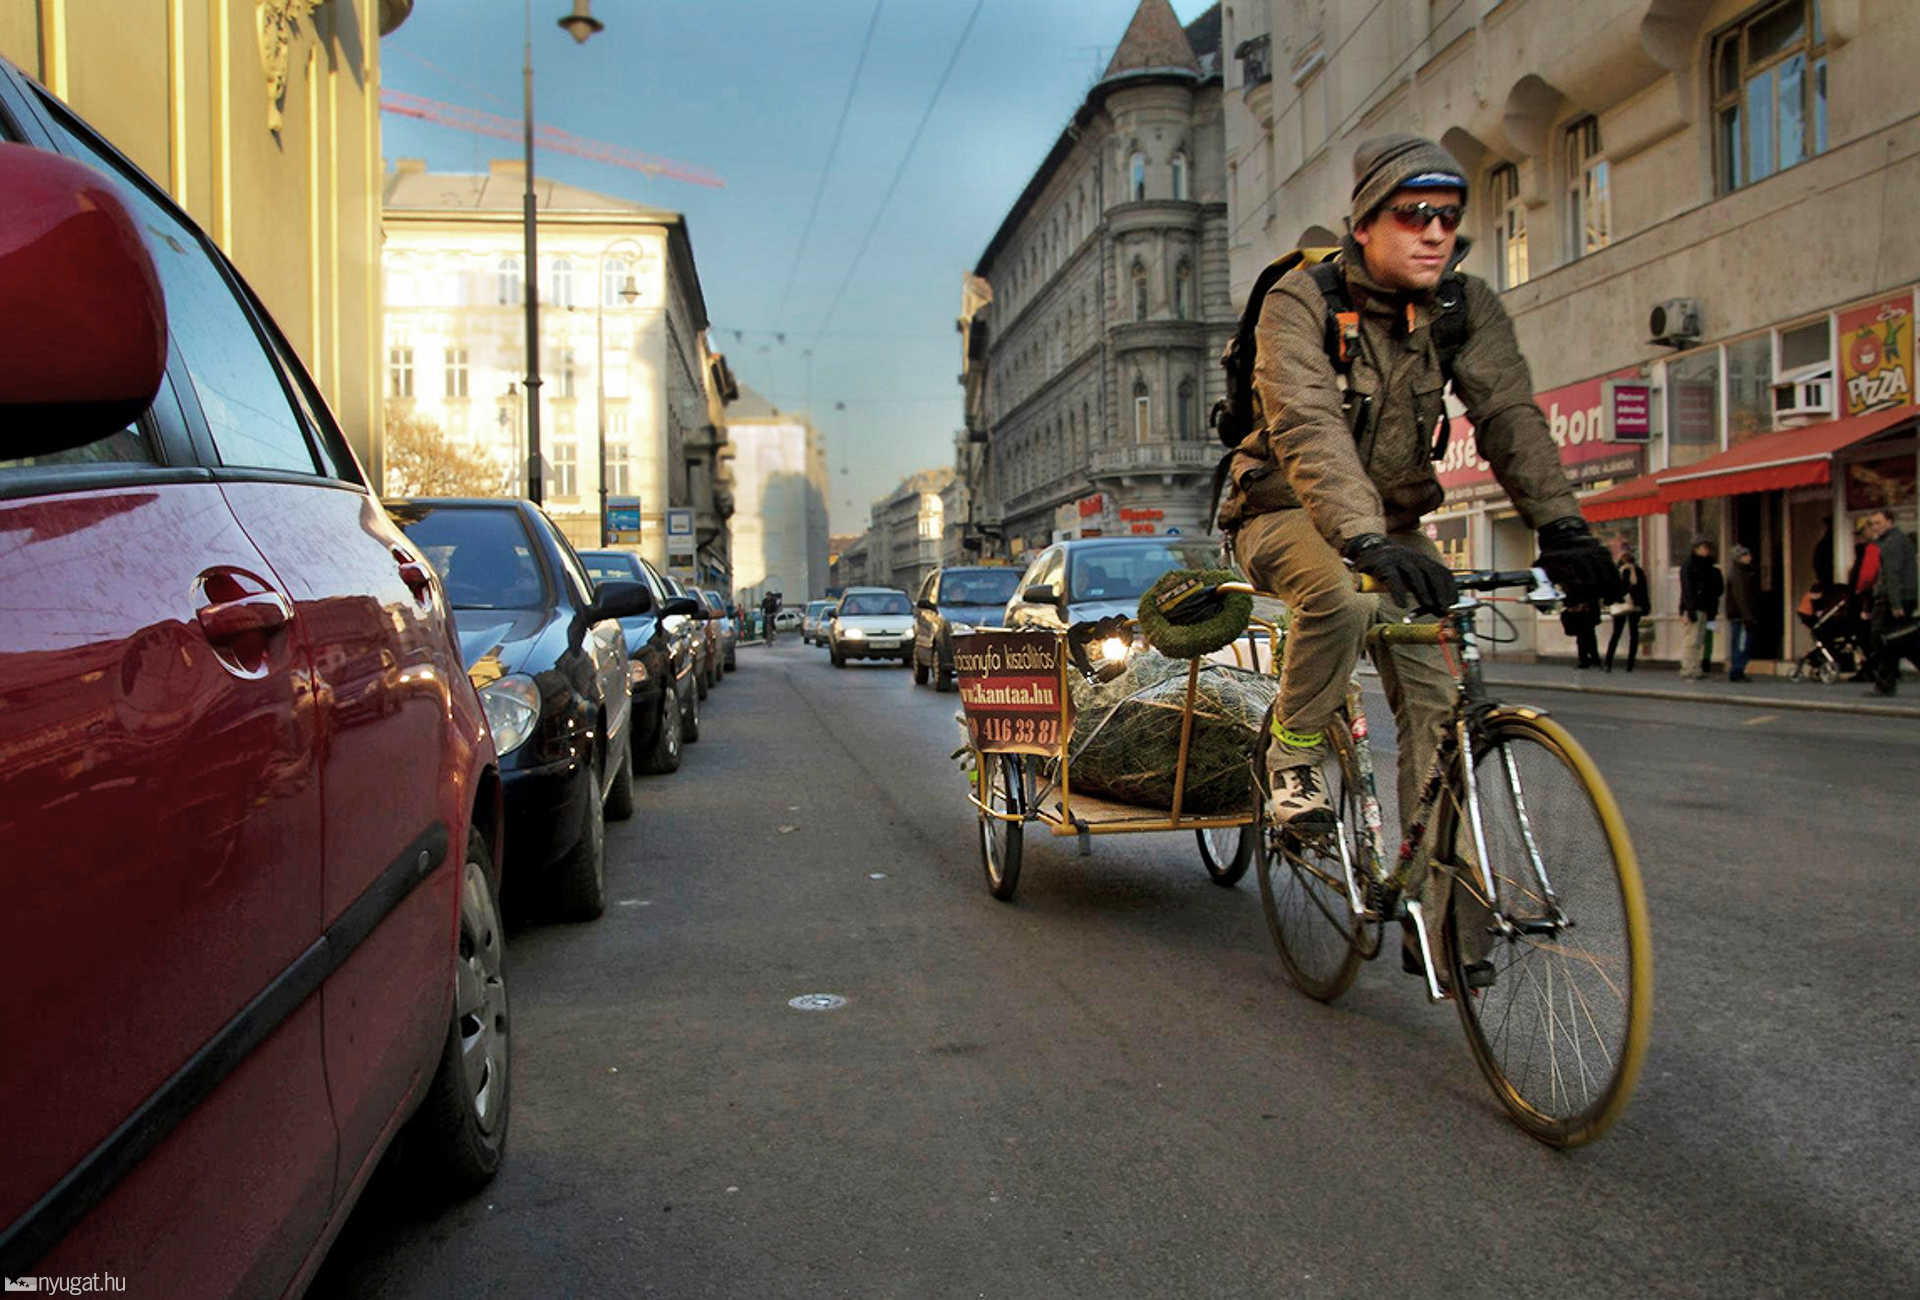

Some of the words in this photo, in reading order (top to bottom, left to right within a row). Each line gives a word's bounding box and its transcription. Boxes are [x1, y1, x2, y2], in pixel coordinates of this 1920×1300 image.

[1846, 365, 1908, 406] PIZZA
[984, 718, 1012, 744] 416
[1015, 718, 1035, 744] 33
[1038, 719, 1058, 745] 81
